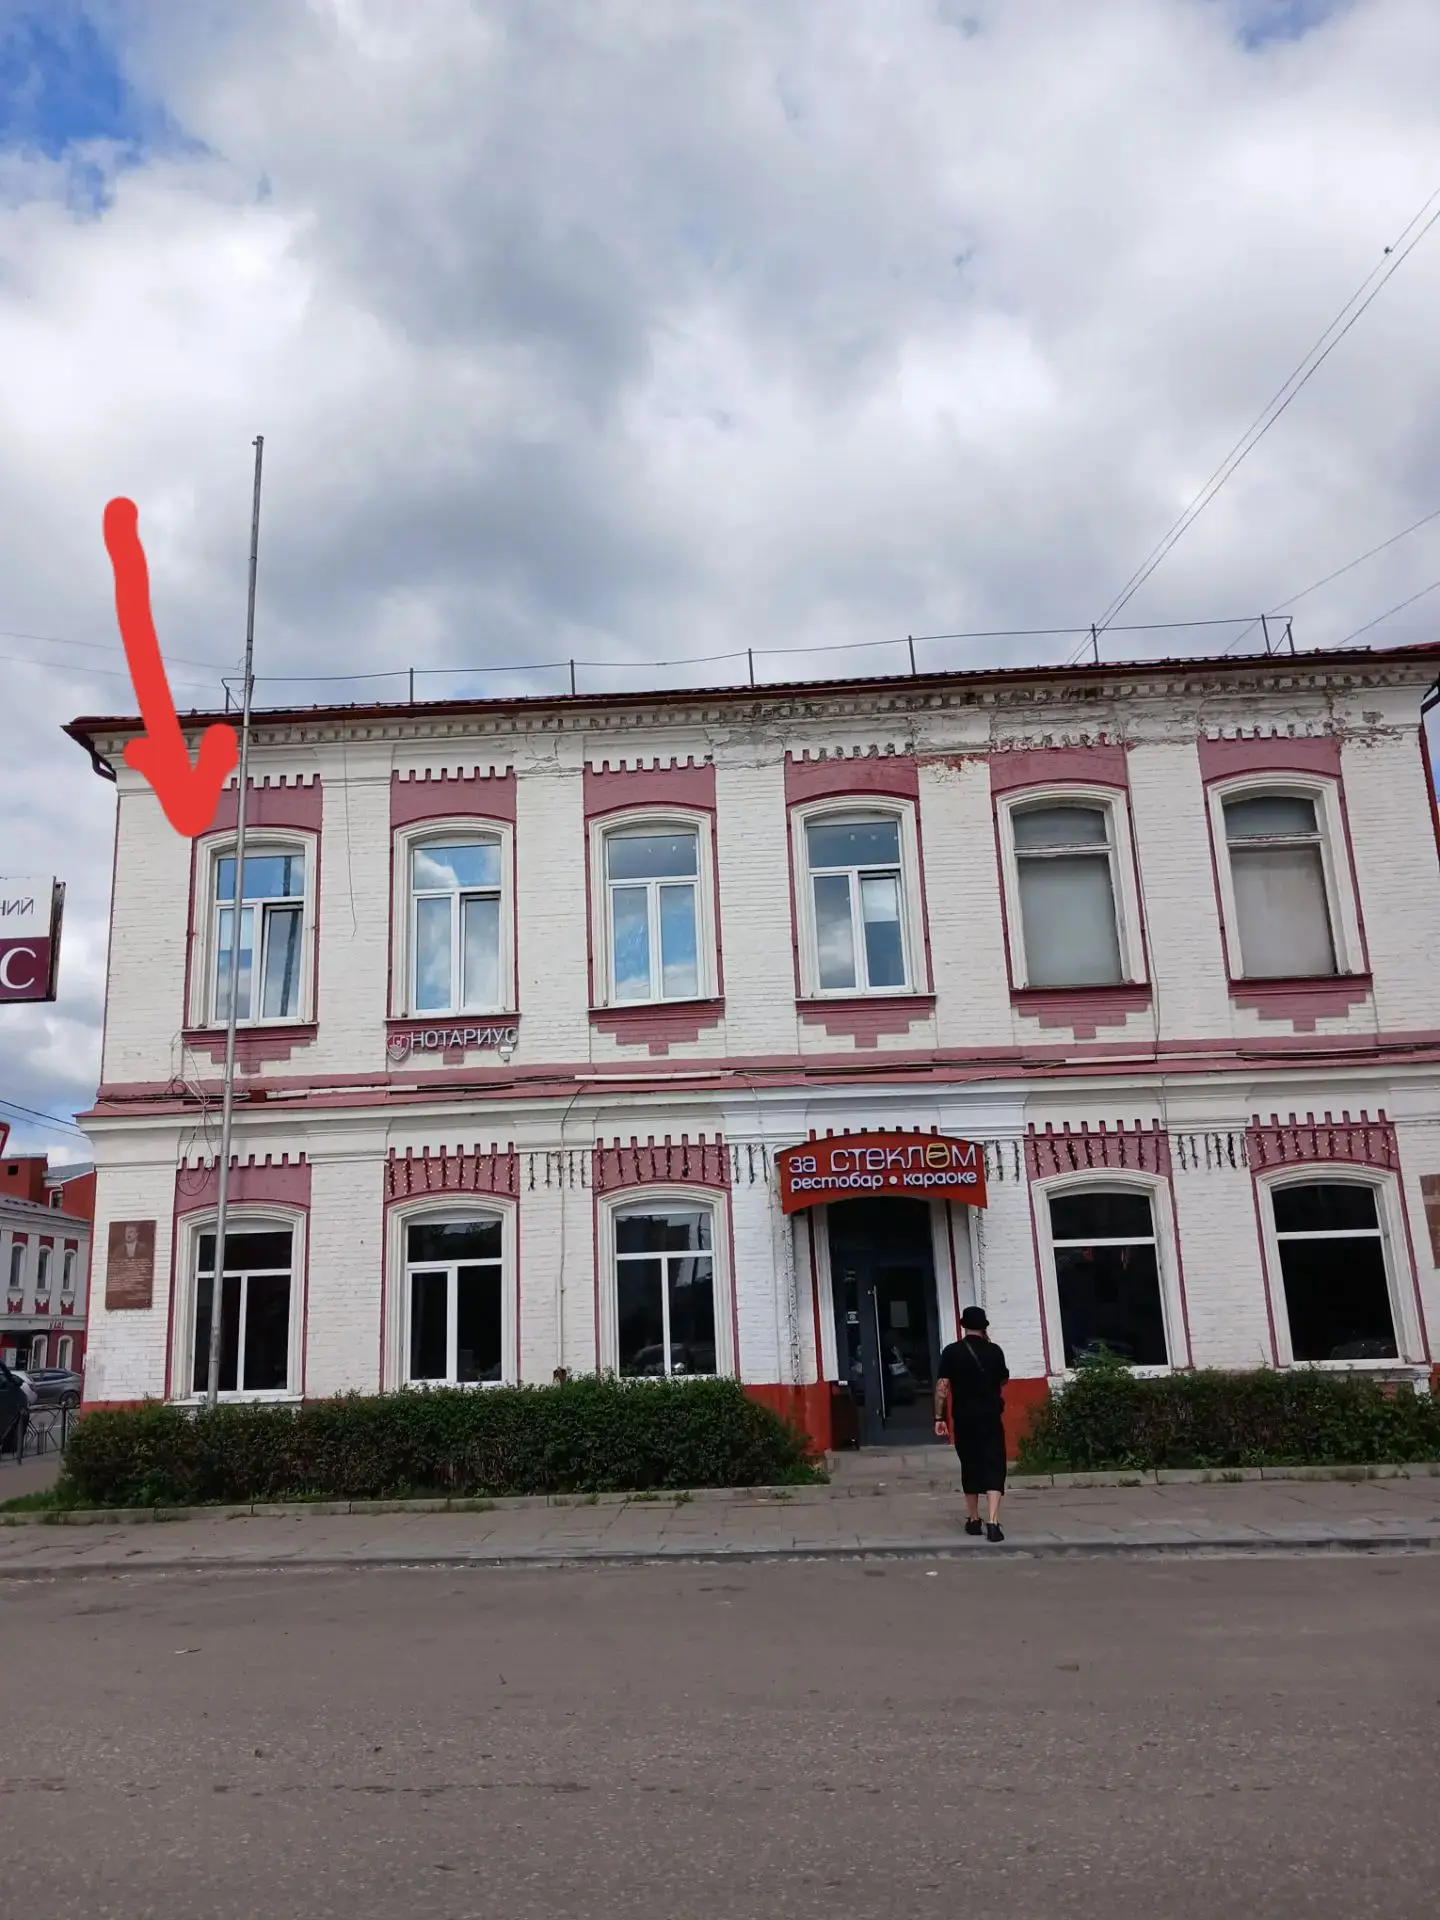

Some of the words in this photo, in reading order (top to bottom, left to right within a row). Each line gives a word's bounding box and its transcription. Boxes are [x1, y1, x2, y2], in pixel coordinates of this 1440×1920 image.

[410, 1027, 517, 1048] НОТАРИУС
[788, 1156, 817, 1173] за
[790, 1172, 884, 1192] рестобар
[903, 1171, 978, 1187] караоке
